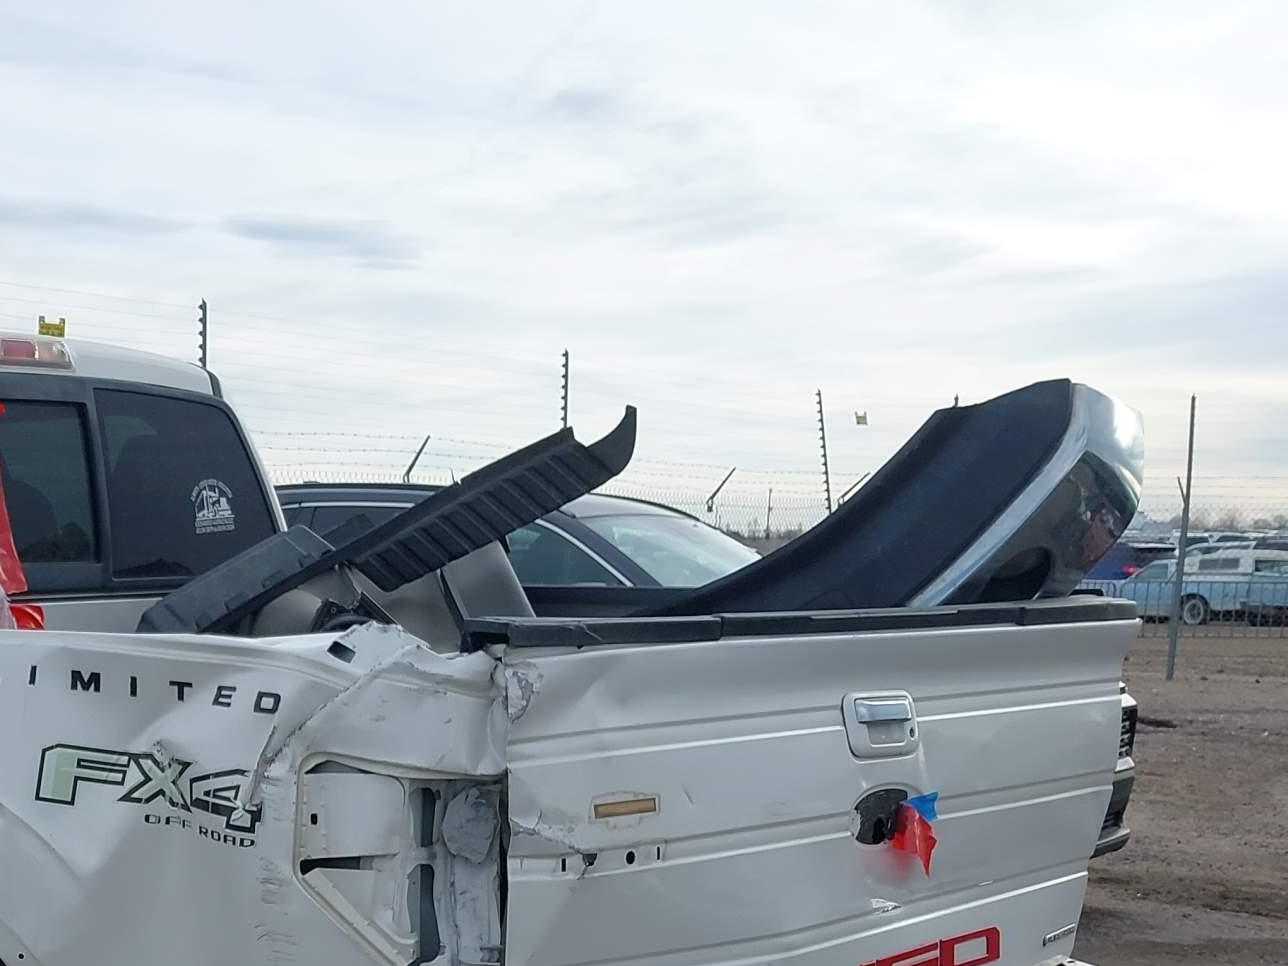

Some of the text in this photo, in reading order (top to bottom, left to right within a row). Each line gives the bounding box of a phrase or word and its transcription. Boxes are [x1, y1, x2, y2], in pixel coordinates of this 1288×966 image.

[35, 743, 264, 834] FX4
[144, 813, 256, 848] OFF ROAD
